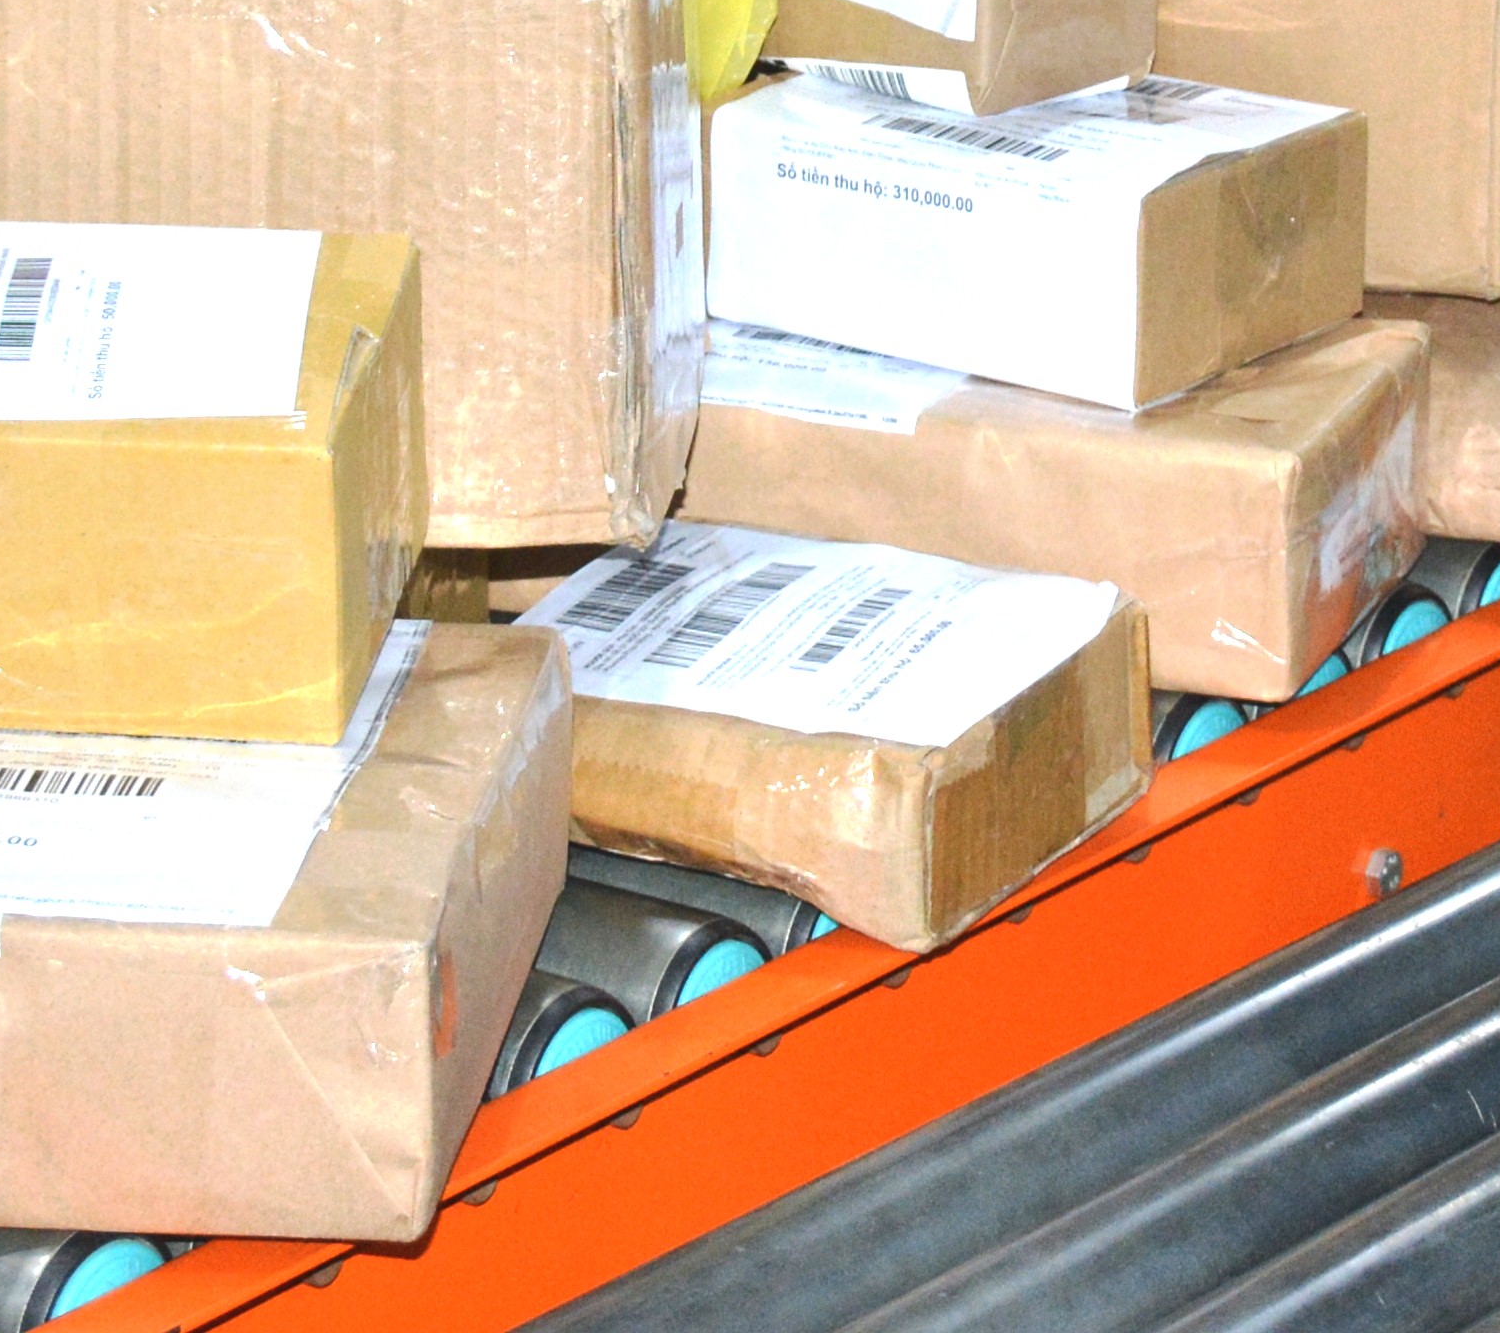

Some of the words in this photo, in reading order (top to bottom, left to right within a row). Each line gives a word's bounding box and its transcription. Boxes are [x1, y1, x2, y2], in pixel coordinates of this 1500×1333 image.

[776, 162, 797, 180] Số
[802, 166, 829, 186] tiền
[834, 174, 859, 192] thu
[864, 179, 888, 199] hộ:
[893, 184, 973, 213] 310,000.00
